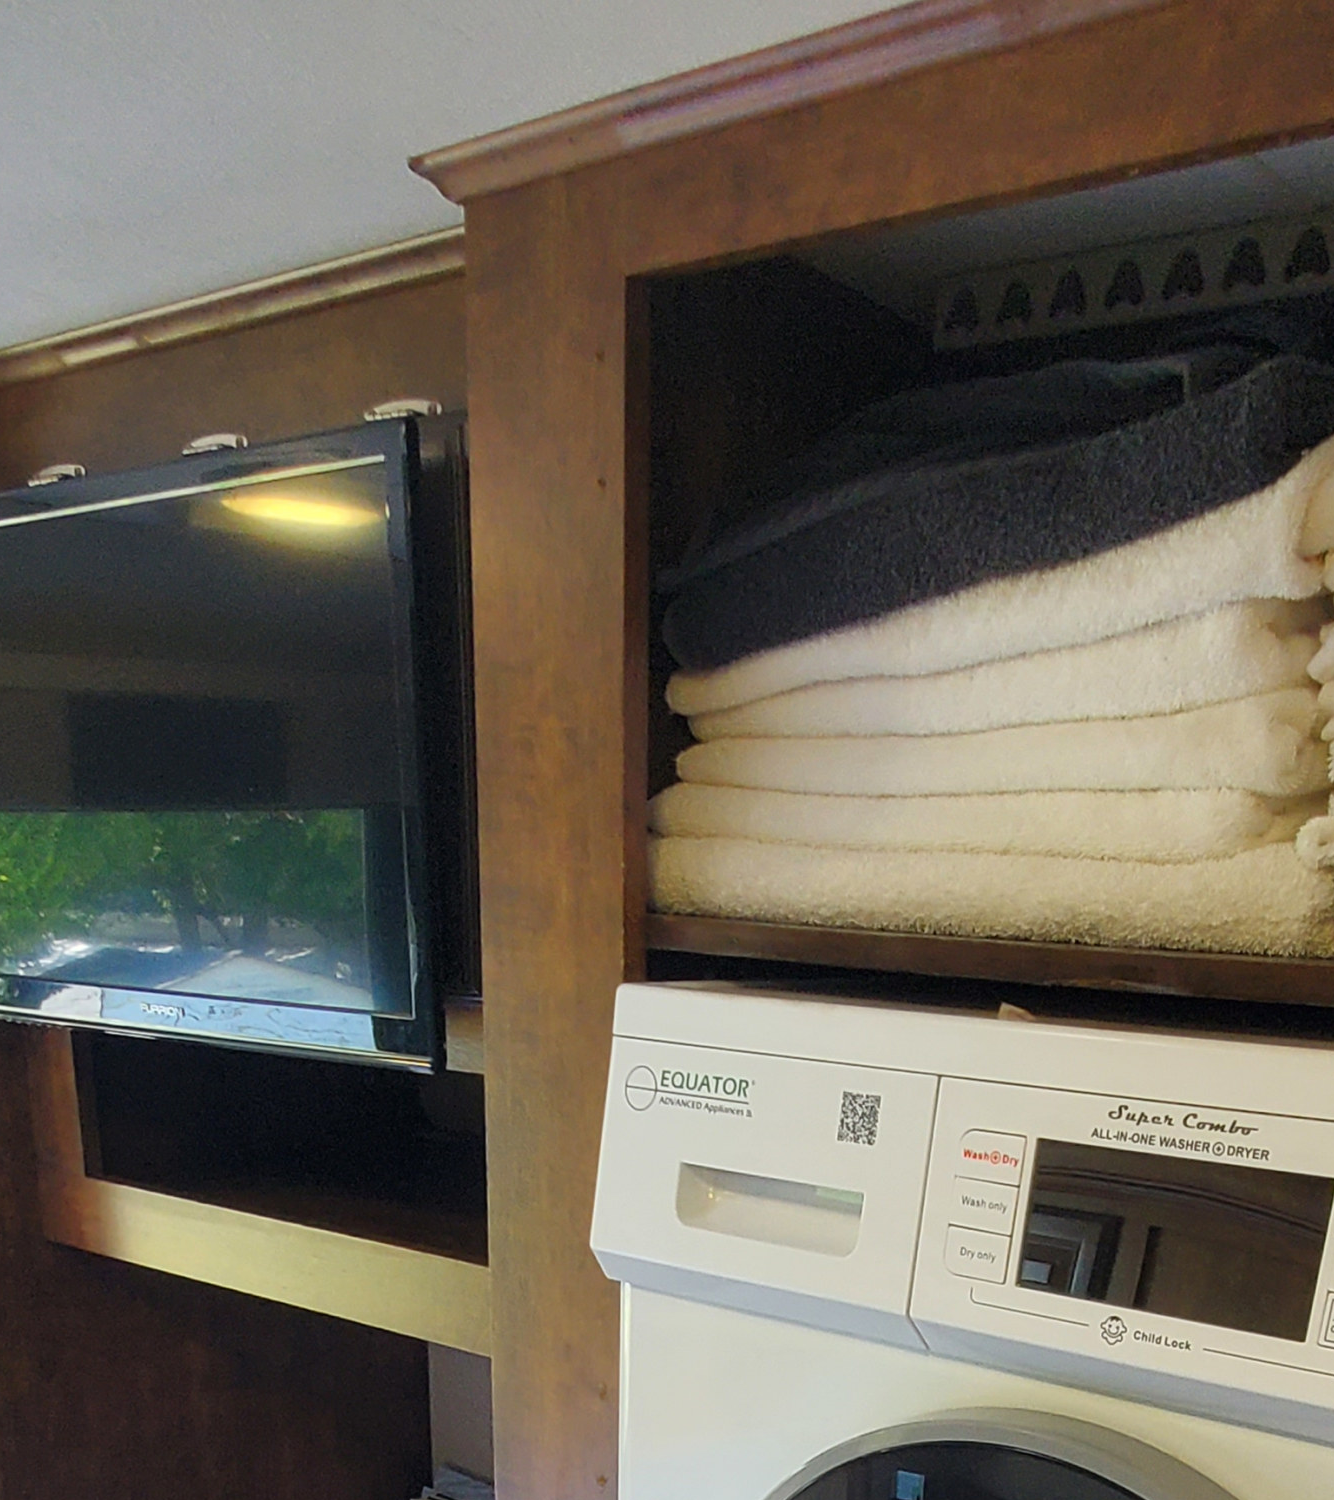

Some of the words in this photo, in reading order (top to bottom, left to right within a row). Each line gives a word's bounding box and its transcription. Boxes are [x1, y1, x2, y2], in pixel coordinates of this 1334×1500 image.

[660, 1069, 750, 1098] EQUATOR
[659, 1096, 702, 1110] ADVANCED
[704, 1102, 745, 1117] Appliances
[1108, 1104, 1175, 1127] Super
[1182, 1112, 1259, 1136] Combo
[1091, 1127, 1157, 1147] ALL-IN-ONE
[1158, 1135, 1211, 1154] WASHER
[1226, 1144, 1271, 1162] DRYER
[960, 1194, 987, 1209] Wash
[987, 1201, 1008, 1215] only
[959, 1246, 976, 1261] Dry
[976, 1250, 997, 1264] only
[1133, 1330, 1163, 1346] Child
[1164, 1335, 1192, 1351] Lock
